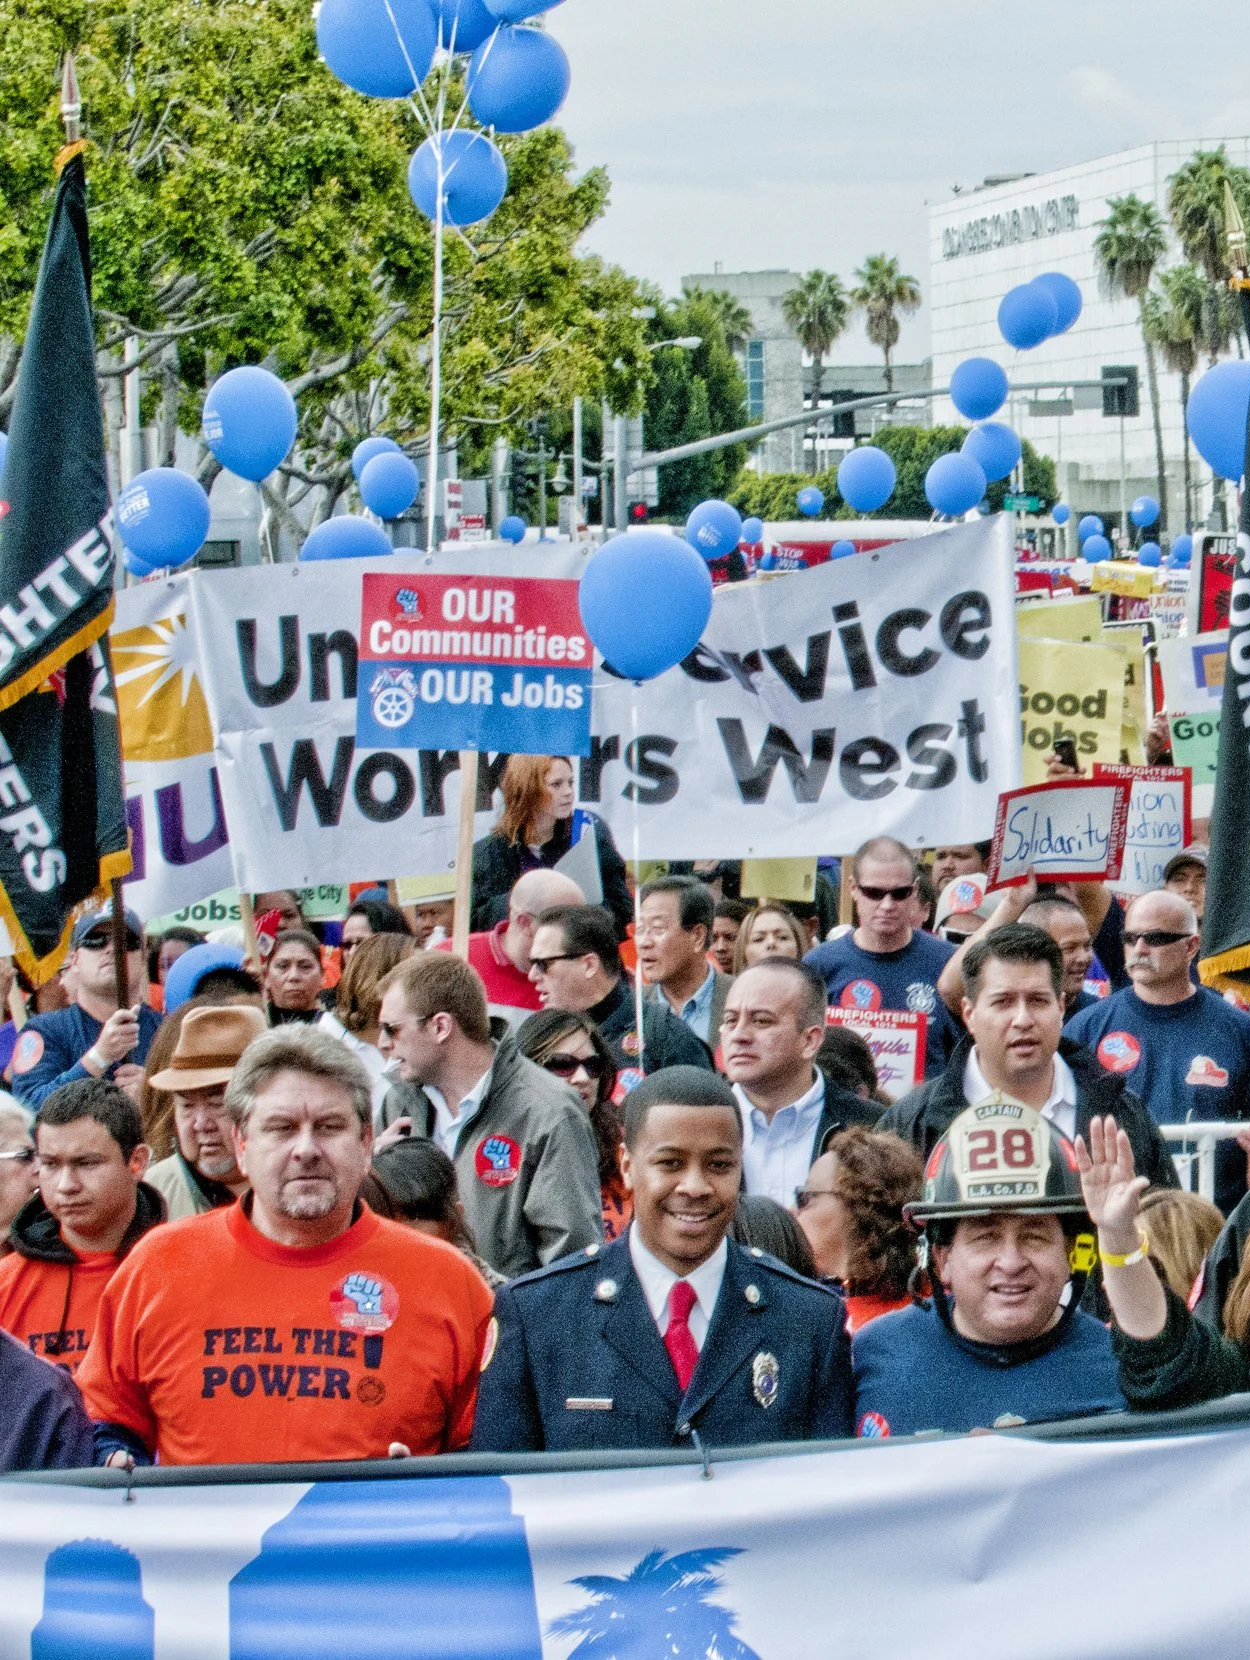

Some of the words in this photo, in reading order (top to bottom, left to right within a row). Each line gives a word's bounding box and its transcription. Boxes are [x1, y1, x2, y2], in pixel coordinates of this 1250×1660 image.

[442, 588, 516, 624] OUR
[369, 618, 587, 662] Communities
[421, 670, 494, 705] OUR
[501, 674, 583, 711] Jobs
[717, 699, 988, 804] West
[1101, 765, 1183, 777] FIREFIGHTERS
[1003, 806, 1110, 864] Solidarity
[1108, 786, 1124, 865] FIREFIGHTERS
[318, 884, 343, 904] City
[826, 1007, 917, 1023] FIREFIGHTERS
[842, 1019, 870, 1028] LOCAL
[977, 1105, 1021, 1119] CAPTAIN
[968, 1129, 1034, 1172] 28
[969, 1185, 991, 1197] L.A.
[993, 1184, 1013, 1195] Co.
[1016, 1183, 1038, 1195] F.D.
[28, 1329, 89, 1355] FEEL
[203, 1327, 282, 1356] FEEL
[292, 1327, 357, 1358] THE
